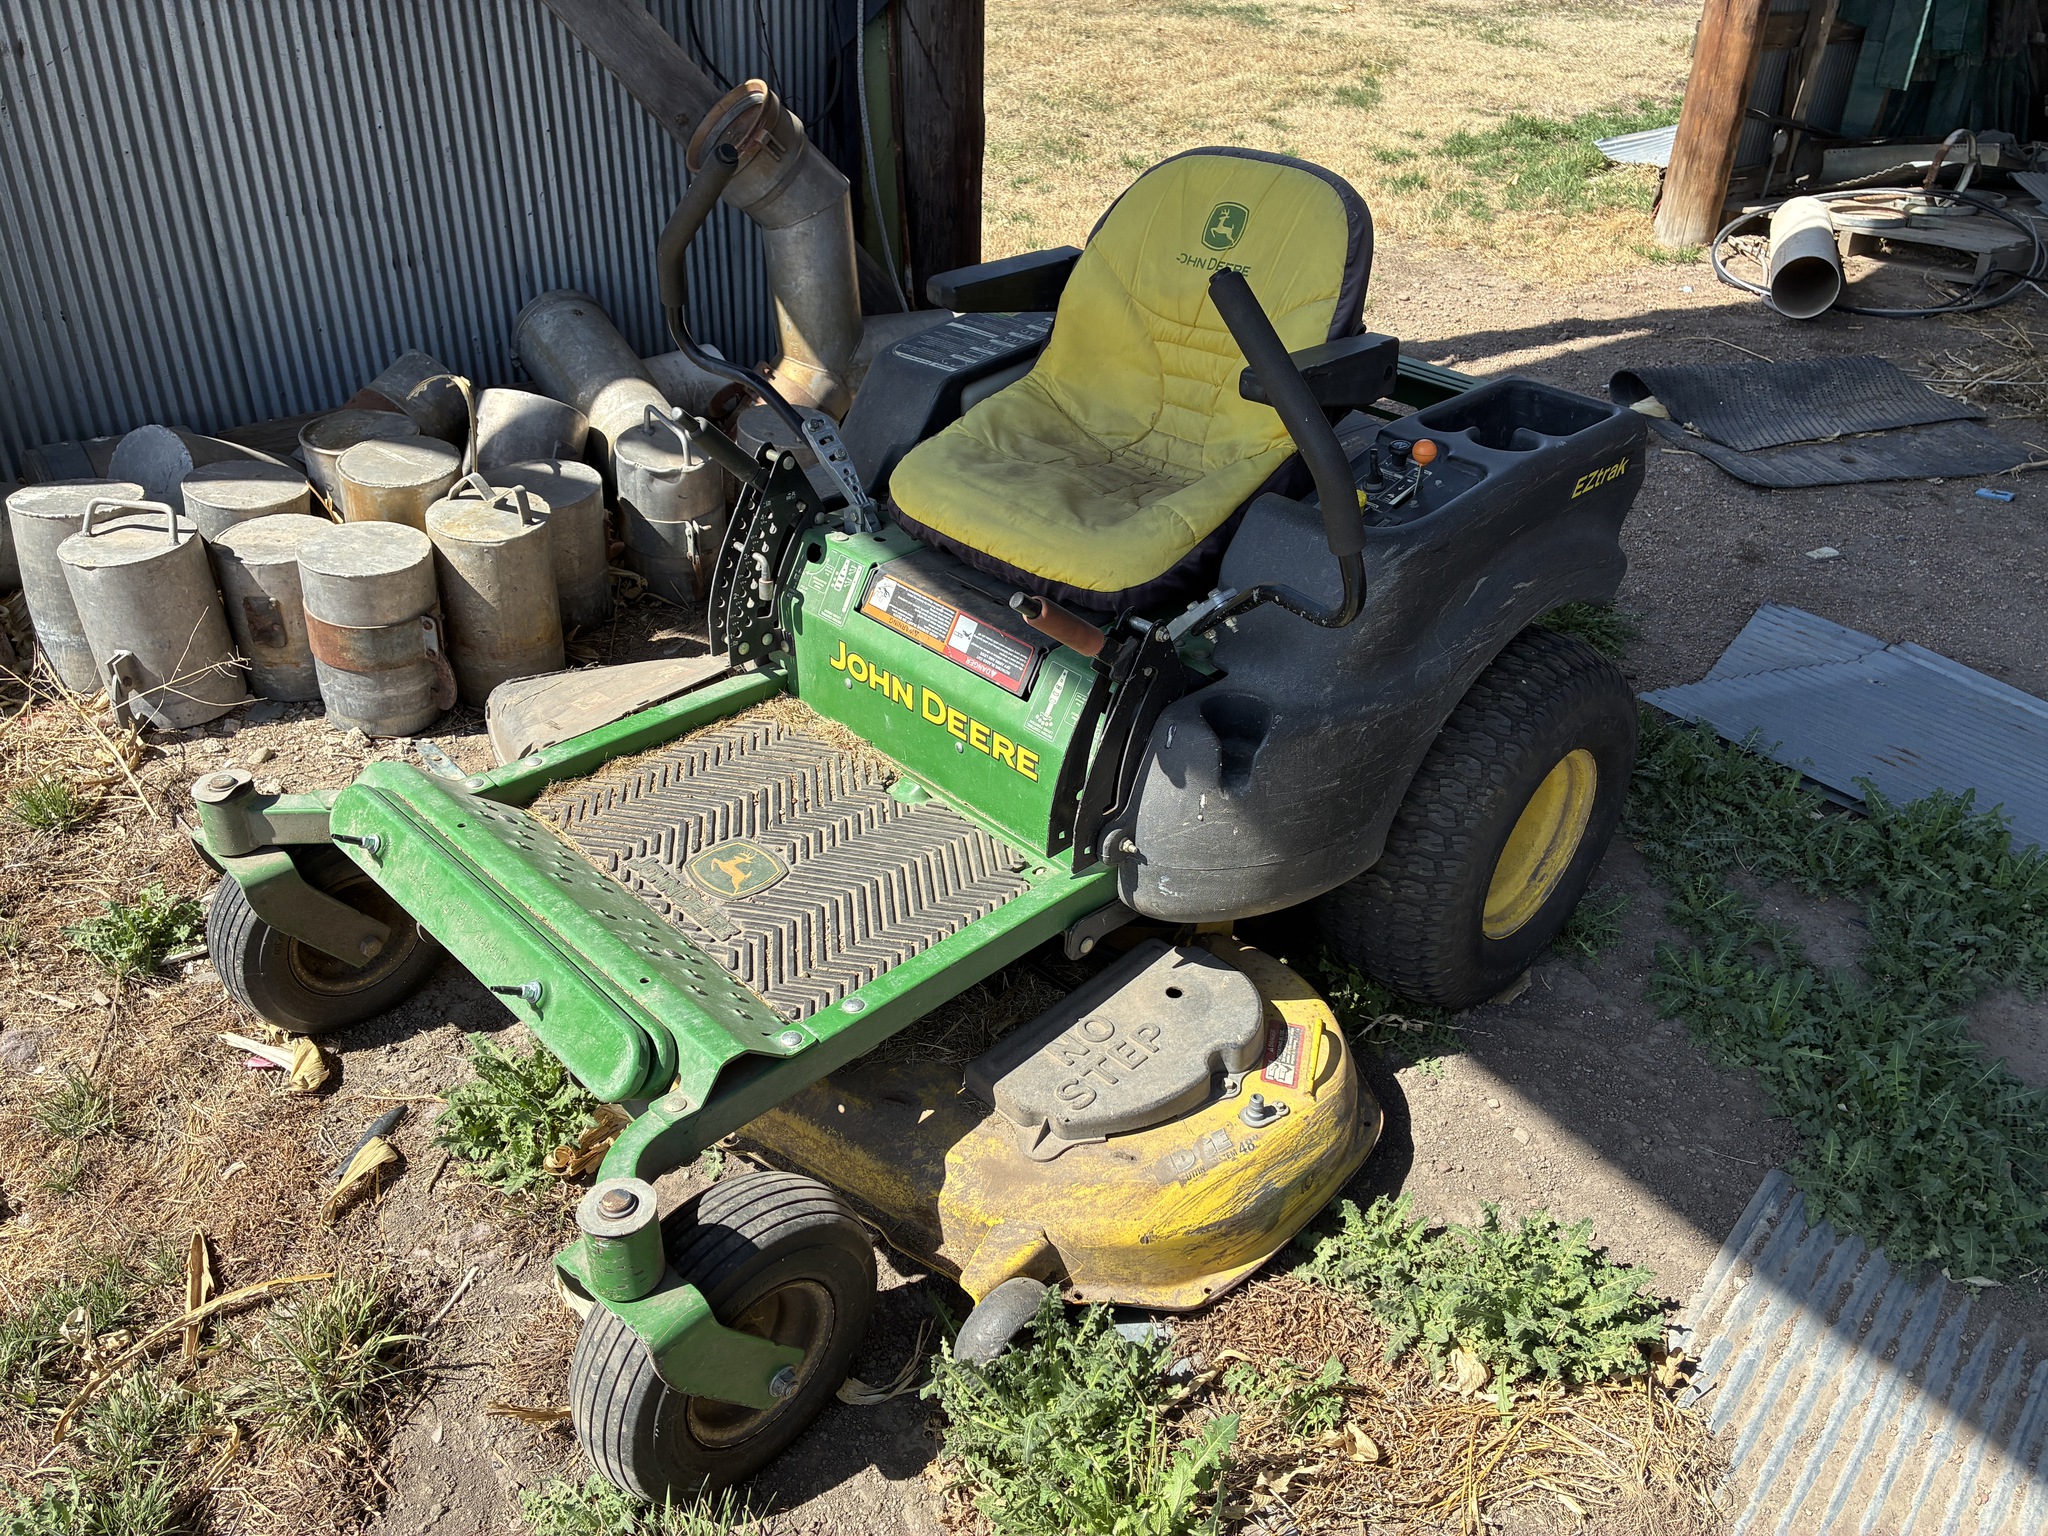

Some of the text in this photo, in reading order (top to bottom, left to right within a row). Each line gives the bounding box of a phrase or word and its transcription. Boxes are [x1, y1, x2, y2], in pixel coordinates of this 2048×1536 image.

[1176, 252, 1207, 269] OHN
[1571, 456, 1630, 499] EZtrak
[966, 657, 990, 674] DANGER
[830, 640, 1040, 783] JOHN DEERE
[627, 856, 688, 897] JOHN
[1044, 1014, 1115, 1066] NO
[1054, 1022, 1161, 1110] STEP
